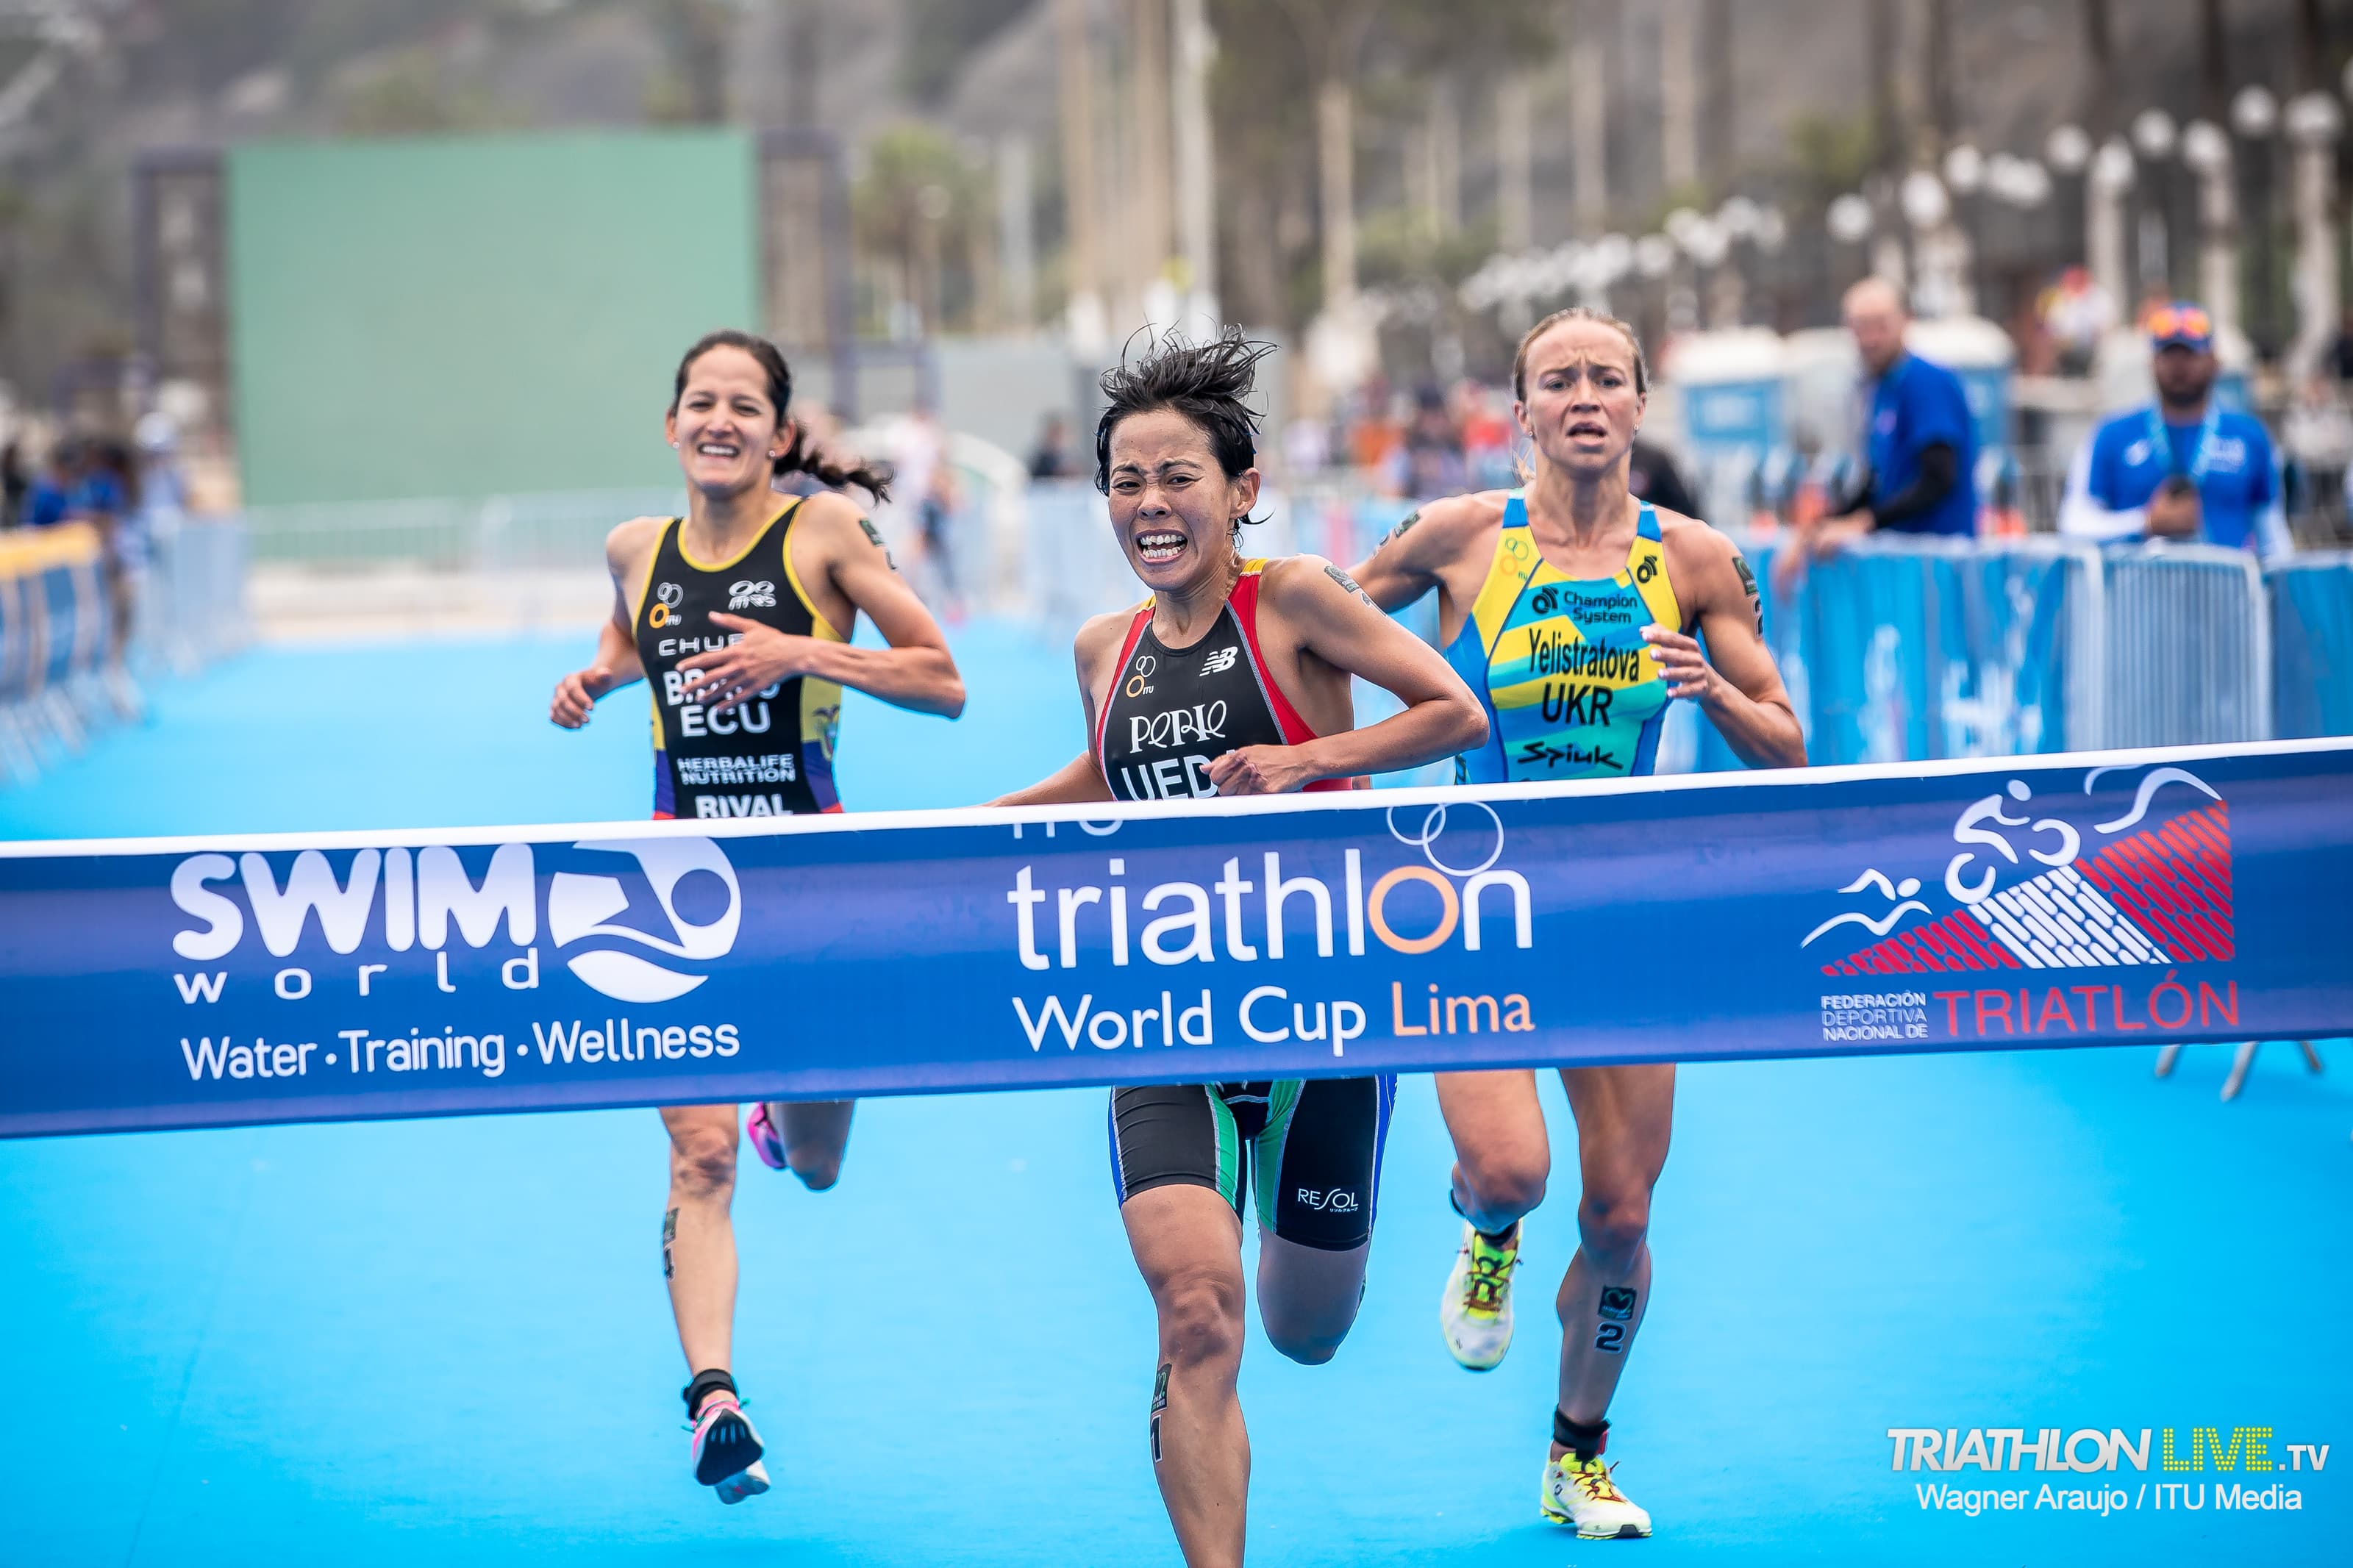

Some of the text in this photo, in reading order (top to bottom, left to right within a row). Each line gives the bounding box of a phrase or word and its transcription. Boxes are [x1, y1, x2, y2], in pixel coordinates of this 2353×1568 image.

[1564, 590, 1638, 610] Champion
[1572, 607, 1632, 625] System
[1528, 627, 1640, 683] Yelistratova
[679, 701, 771, 737] ECU
[1541, 681, 1614, 727] UKR
[676, 753, 794, 772] HERBALIFE
[1517, 740, 1624, 769] Spiuk
[680, 767, 796, 785] NUTRITION
[1121, 749, 1236, 802] UED
[694, 794, 794, 819] RIVAL
[170, 842, 537, 961] SWIM
[1006, 848, 1533, 971] triathlon
[1821, 989, 1927, 1010] FEDERACIÓN
[1932, 969, 2240, 1037] TRIATLÓN
[1012, 981, 1536, 1057] World Cup Lima
[1821, 1007, 1927, 1026] DEPORTIVA
[1822, 1023, 1929, 1042] NACIONAL DE
[180, 1018, 740, 1081] Water Training Wellness
[1297, 1188, 1359, 1210] RESOL
[1595, 1322, 1626, 1353] 2
[1150, 1414, 1163, 1463] 1
